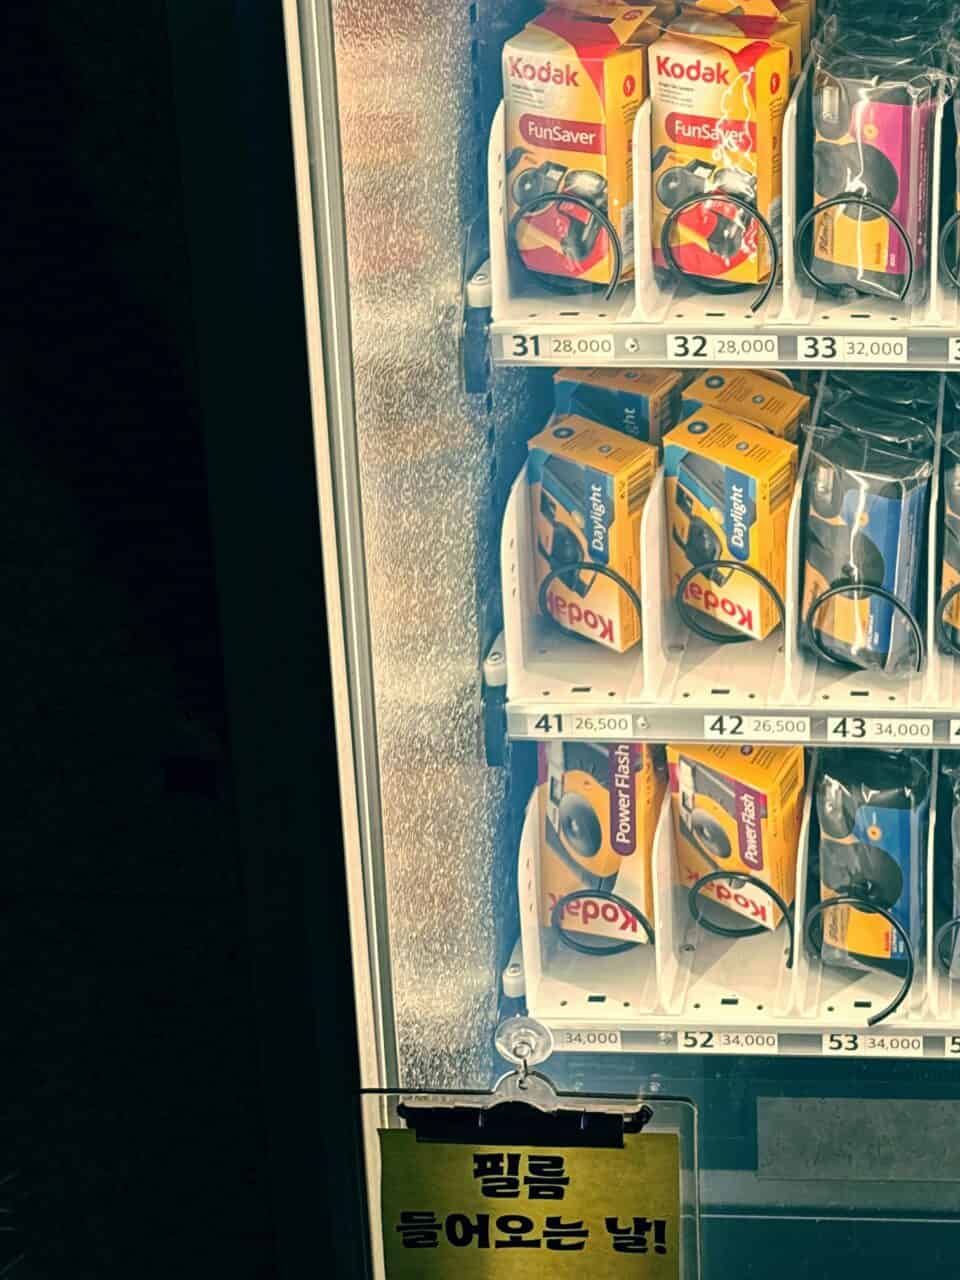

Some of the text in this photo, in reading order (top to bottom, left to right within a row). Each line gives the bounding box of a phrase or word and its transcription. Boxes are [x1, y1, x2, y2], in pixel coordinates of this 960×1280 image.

[508, 56, 579, 88] Kodak
[655, 55, 729, 86] Kodak
[527, 120, 596, 146] FunSaver
[674, 119, 745, 144] FunSaver
[512, 336, 612, 358] 31 28,000
[674, 336, 776, 358] 32 28,000
[803, 337, 904, 359] 33 32,000
[590, 483, 605, 553] Daylight
[731, 484, 746, 548] Daylight
[534, 713, 629, 734] 41 26,500
[710, 715, 807, 737] 42 26,500
[832, 718, 931, 739] 43 34,000
[615, 787, 632, 844] Power
[745, 793, 758, 863] Power Flash
[564, 1031, 619, 1046] 34,000
[683, 1031, 777, 1048] 52 34,000
[829, 1034, 923, 1051] 53 34,000
[473, 1152, 570, 1200] 필름
[396, 1210, 668, 1255] 들어오는 날!
